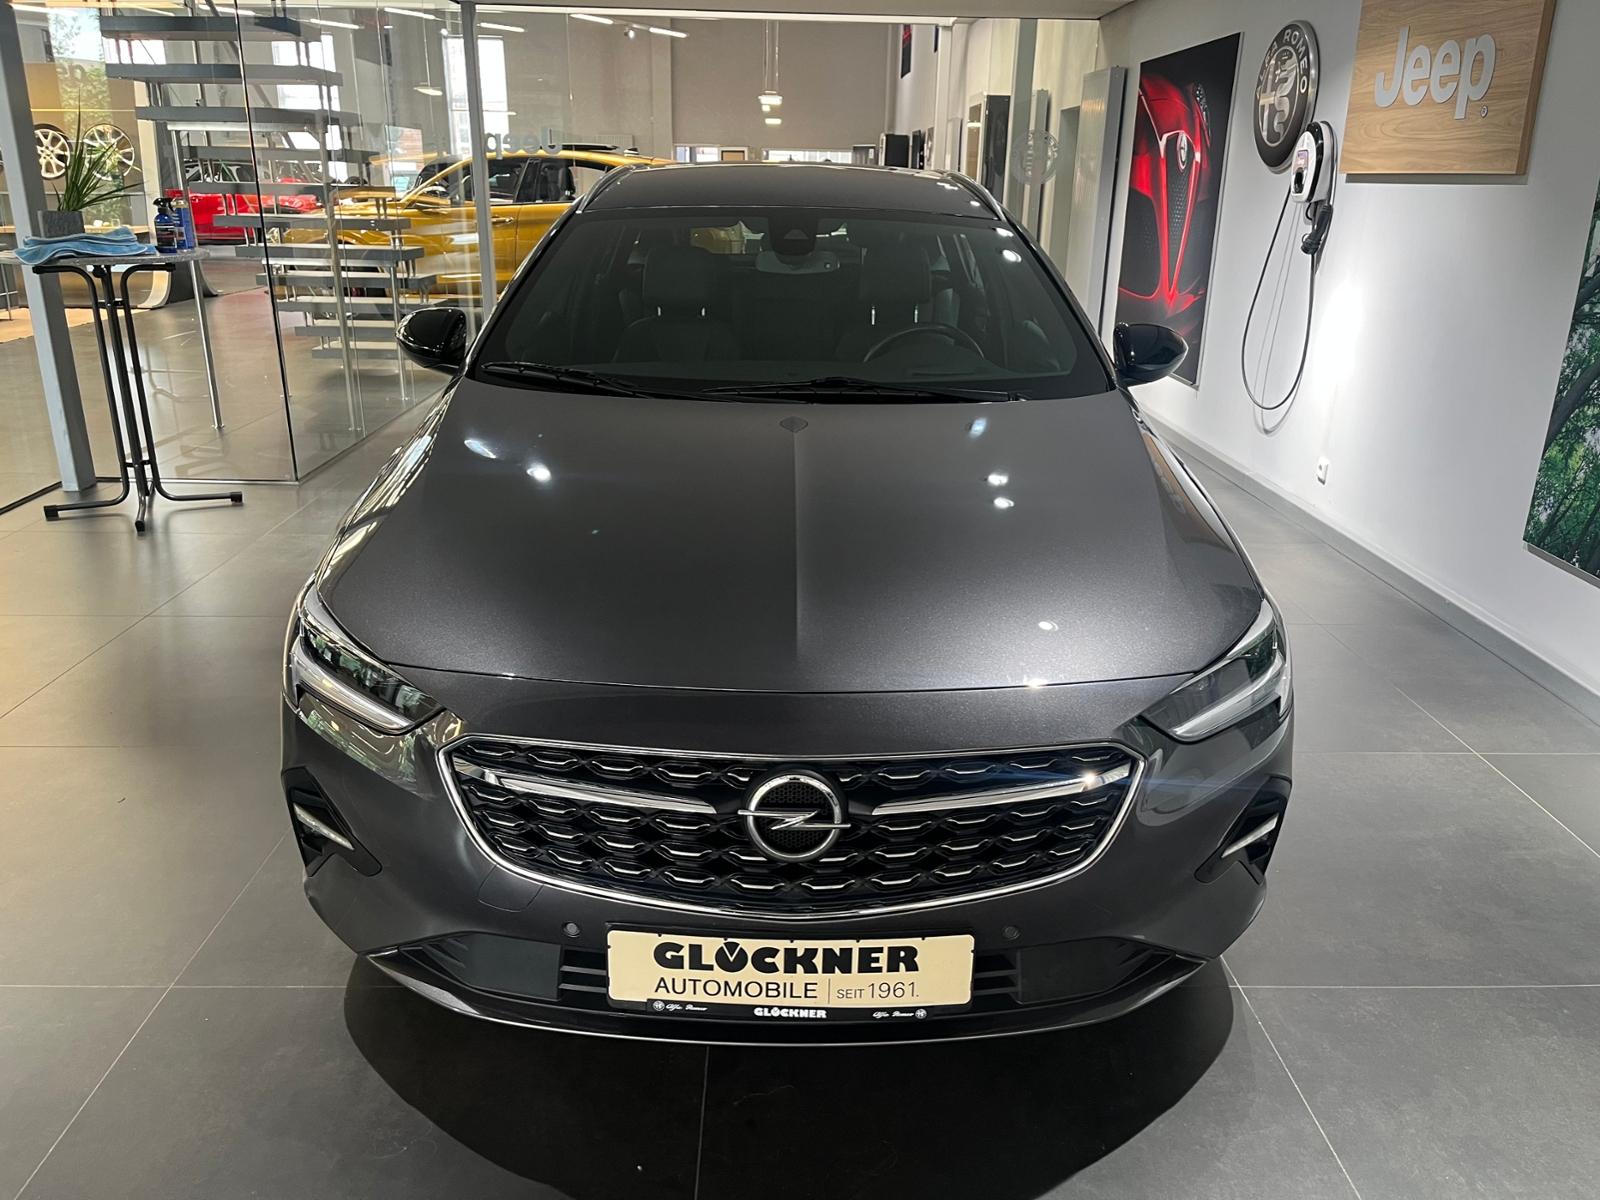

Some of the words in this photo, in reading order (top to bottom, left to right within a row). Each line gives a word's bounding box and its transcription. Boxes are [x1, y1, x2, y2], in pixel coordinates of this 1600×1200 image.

[1282, 28, 1308, 94] ROMEO
[1374, 26, 1496, 120] Jeep
[654, 976, 818, 999] AUTOMOBILE
[836, 988, 866, 999] SEIT
